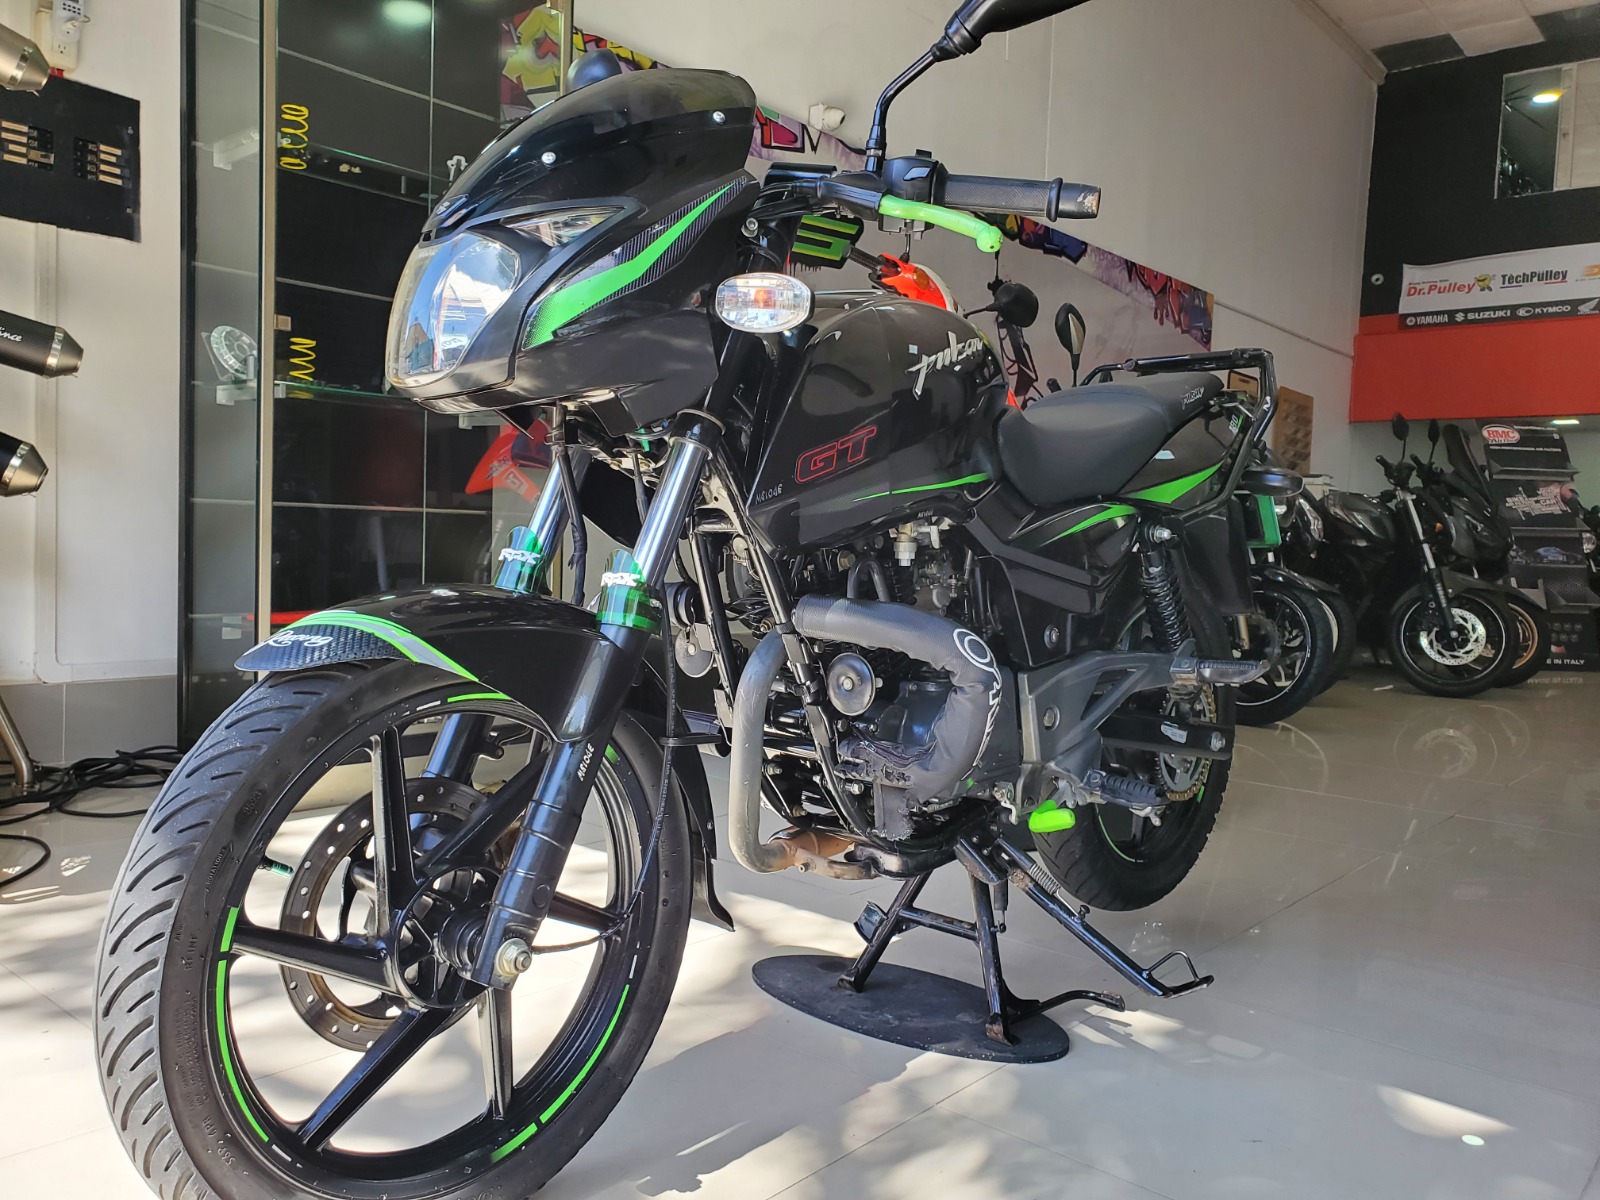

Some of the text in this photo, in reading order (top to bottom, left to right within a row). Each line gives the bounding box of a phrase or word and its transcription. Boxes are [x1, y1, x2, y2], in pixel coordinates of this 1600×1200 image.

[1467, 309, 1511, 320] SUZUKI
[1535, 305, 1571, 314] KYMCO
[1416, 314, 1448, 325] YAMAHA
[1486, 429, 1516, 439] BMC
[795, 425, 877, 484] GT
